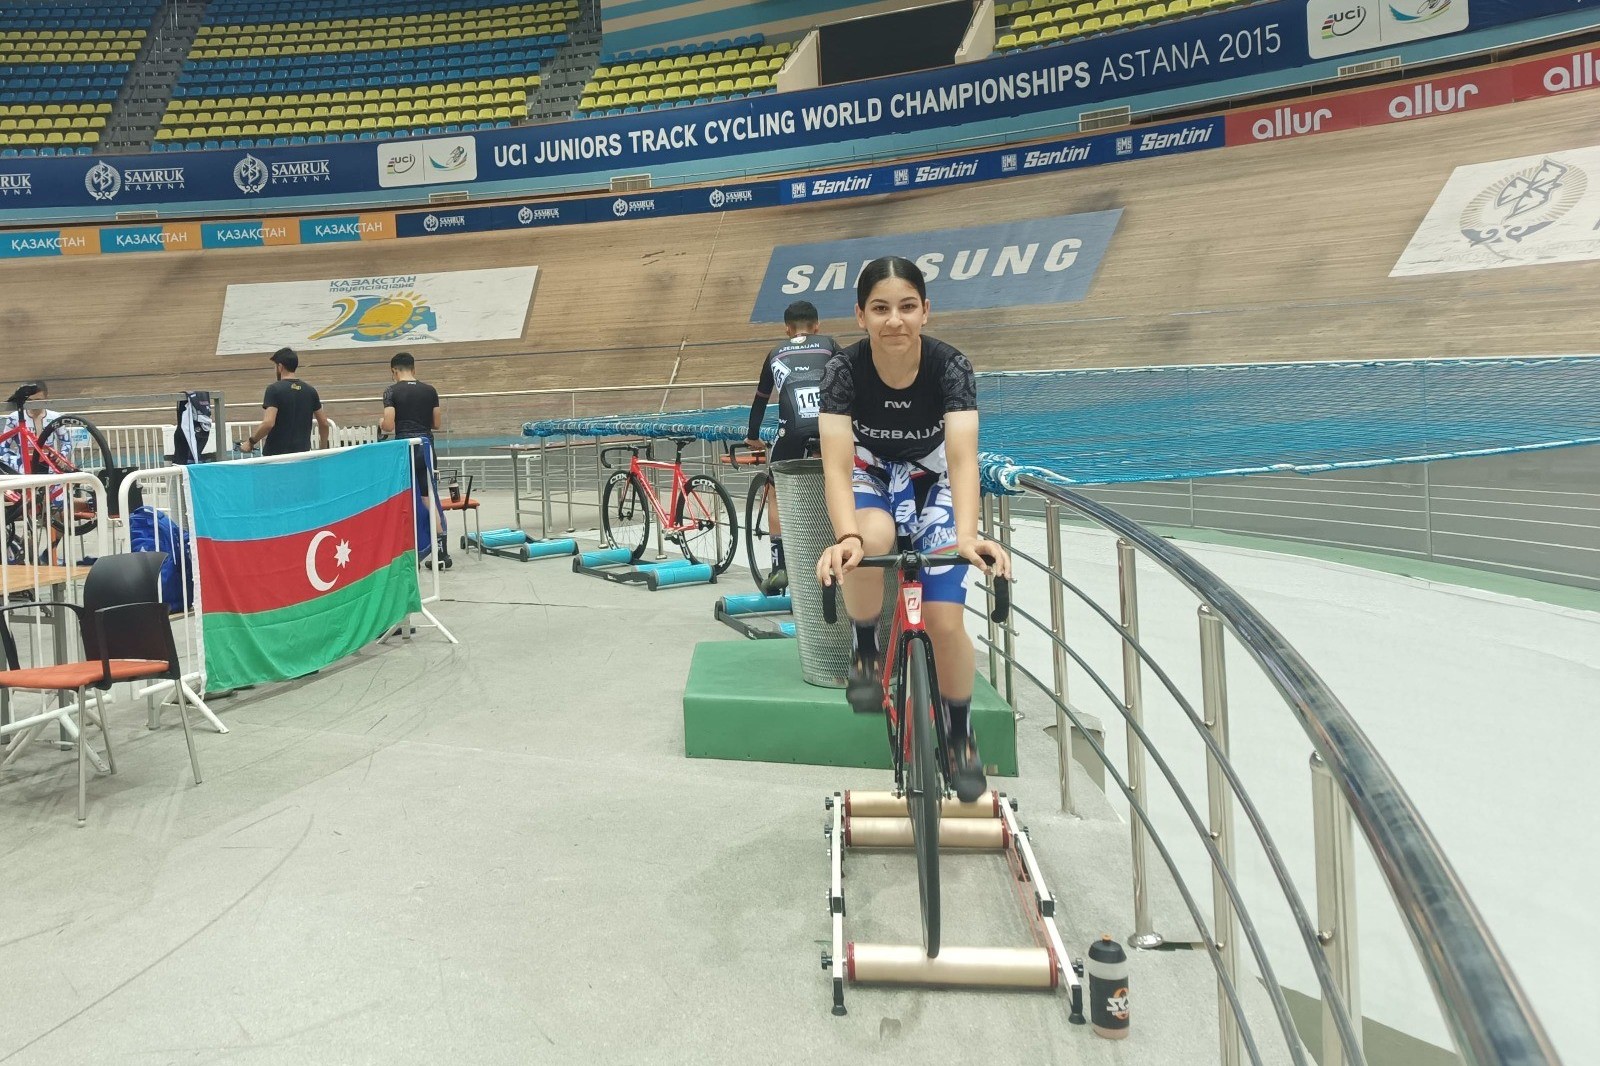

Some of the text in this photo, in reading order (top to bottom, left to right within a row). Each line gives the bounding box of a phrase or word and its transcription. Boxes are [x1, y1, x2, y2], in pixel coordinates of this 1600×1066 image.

[494, 23, 1280, 168] UCI JUNIORS TRACK CYCLING WORLD CHAMPIONSHIPS ASTANA 2015
[1388, 83, 1478, 118] allur
[1252, 107, 1332, 140] allur
[1140, 124, 1214, 151] Santini
[1024, 143, 1091, 168] Santini
[125, 170, 184, 183] SAMRUK
[272, 161, 329, 176] SAMRUK
[272, 175, 330, 184] KAZYNA
[915, 160, 978, 182] Santini
[125, 182, 185, 191] KAZYNA
[812, 174, 872, 196] Santini
[781, 239, 1082, 295] SASUNG
